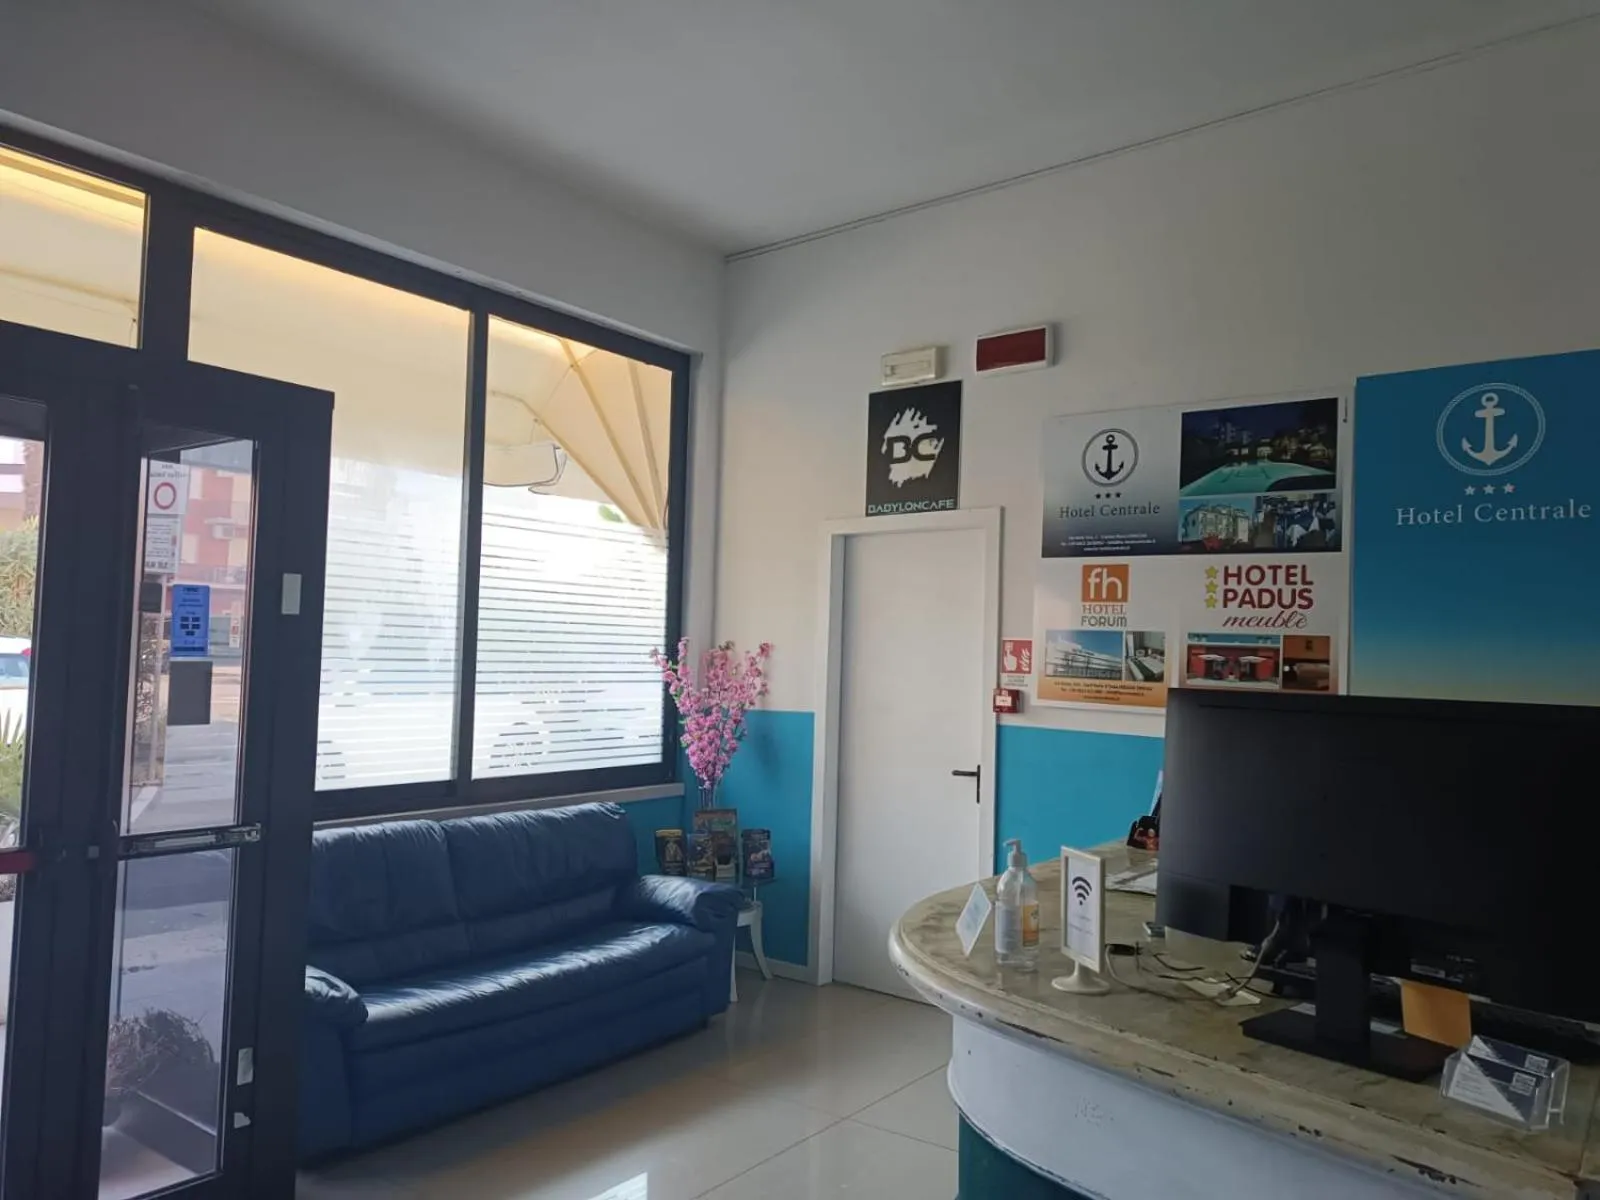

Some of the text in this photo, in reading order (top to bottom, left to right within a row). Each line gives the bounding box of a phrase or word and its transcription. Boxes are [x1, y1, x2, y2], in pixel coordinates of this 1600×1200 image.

[1059, 502, 1160, 518] Hotel Centrale
[1396, 499, 1591, 526] Hotel Centrale
[1087, 567, 1123, 600] fh
[1223, 564, 1314, 586] HOTEL
[1082, 604, 1127, 615] HOTEL
[1222, 588, 1314, 610] PADUS
[1080, 615, 1128, 627] FORUM
